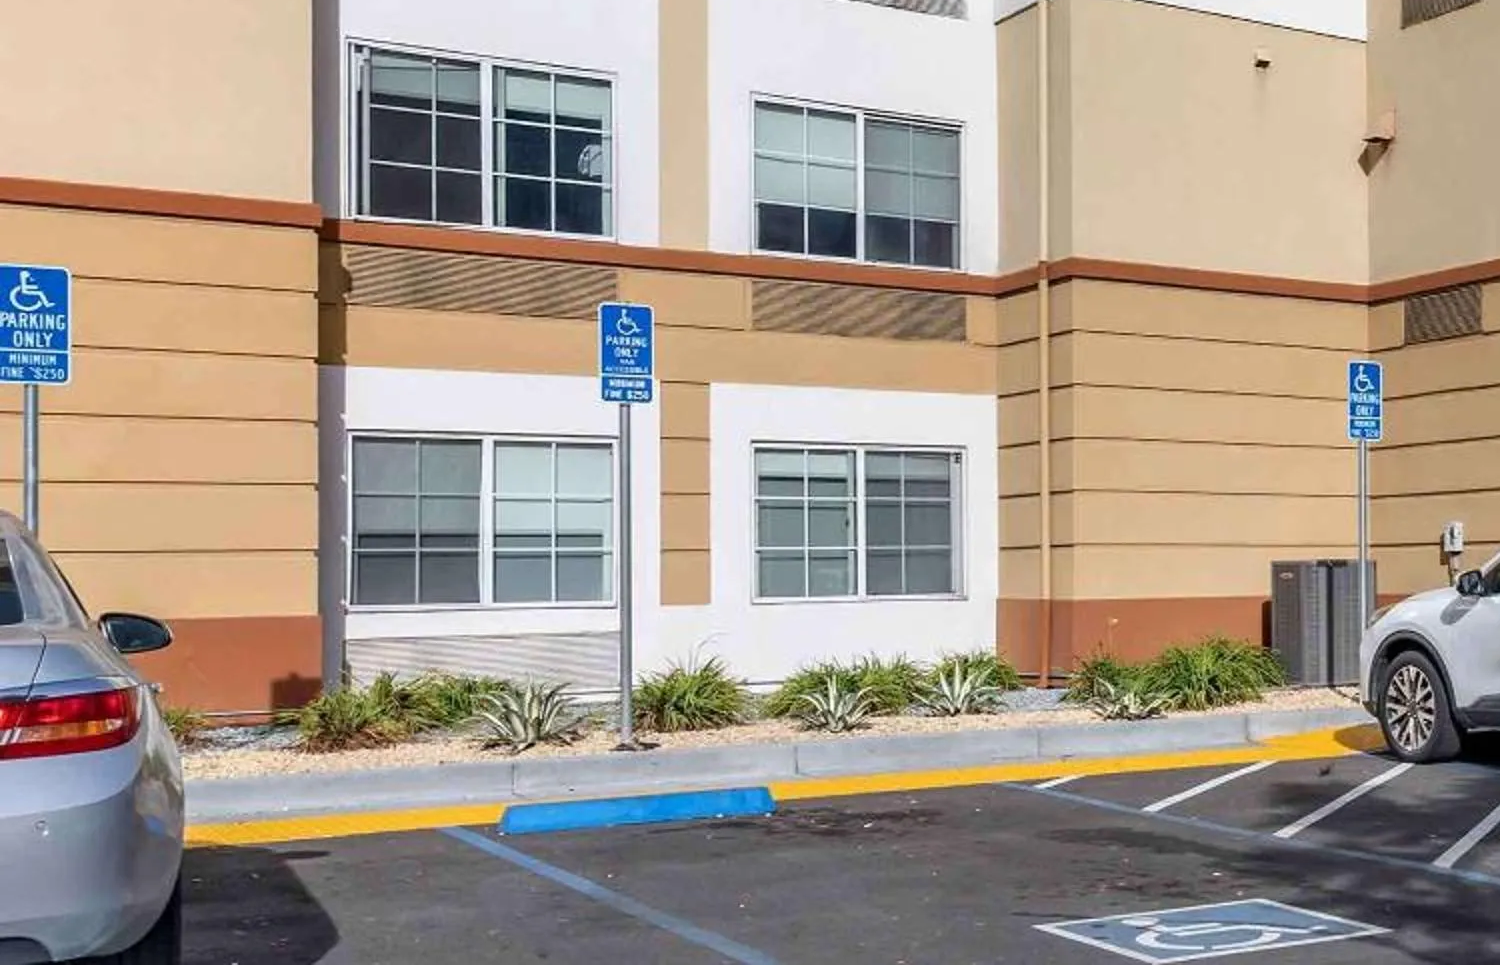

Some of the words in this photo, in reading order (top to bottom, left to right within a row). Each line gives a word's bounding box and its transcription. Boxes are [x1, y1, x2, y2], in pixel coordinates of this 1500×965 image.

[0, 312, 66, 331] PARKING
[13, 330, 53, 348] ONLY
[605, 335, 648, 347] PARKING
[614, 347, 639, 358] ONLY
[9, 353, 57, 366] MINIMUM
